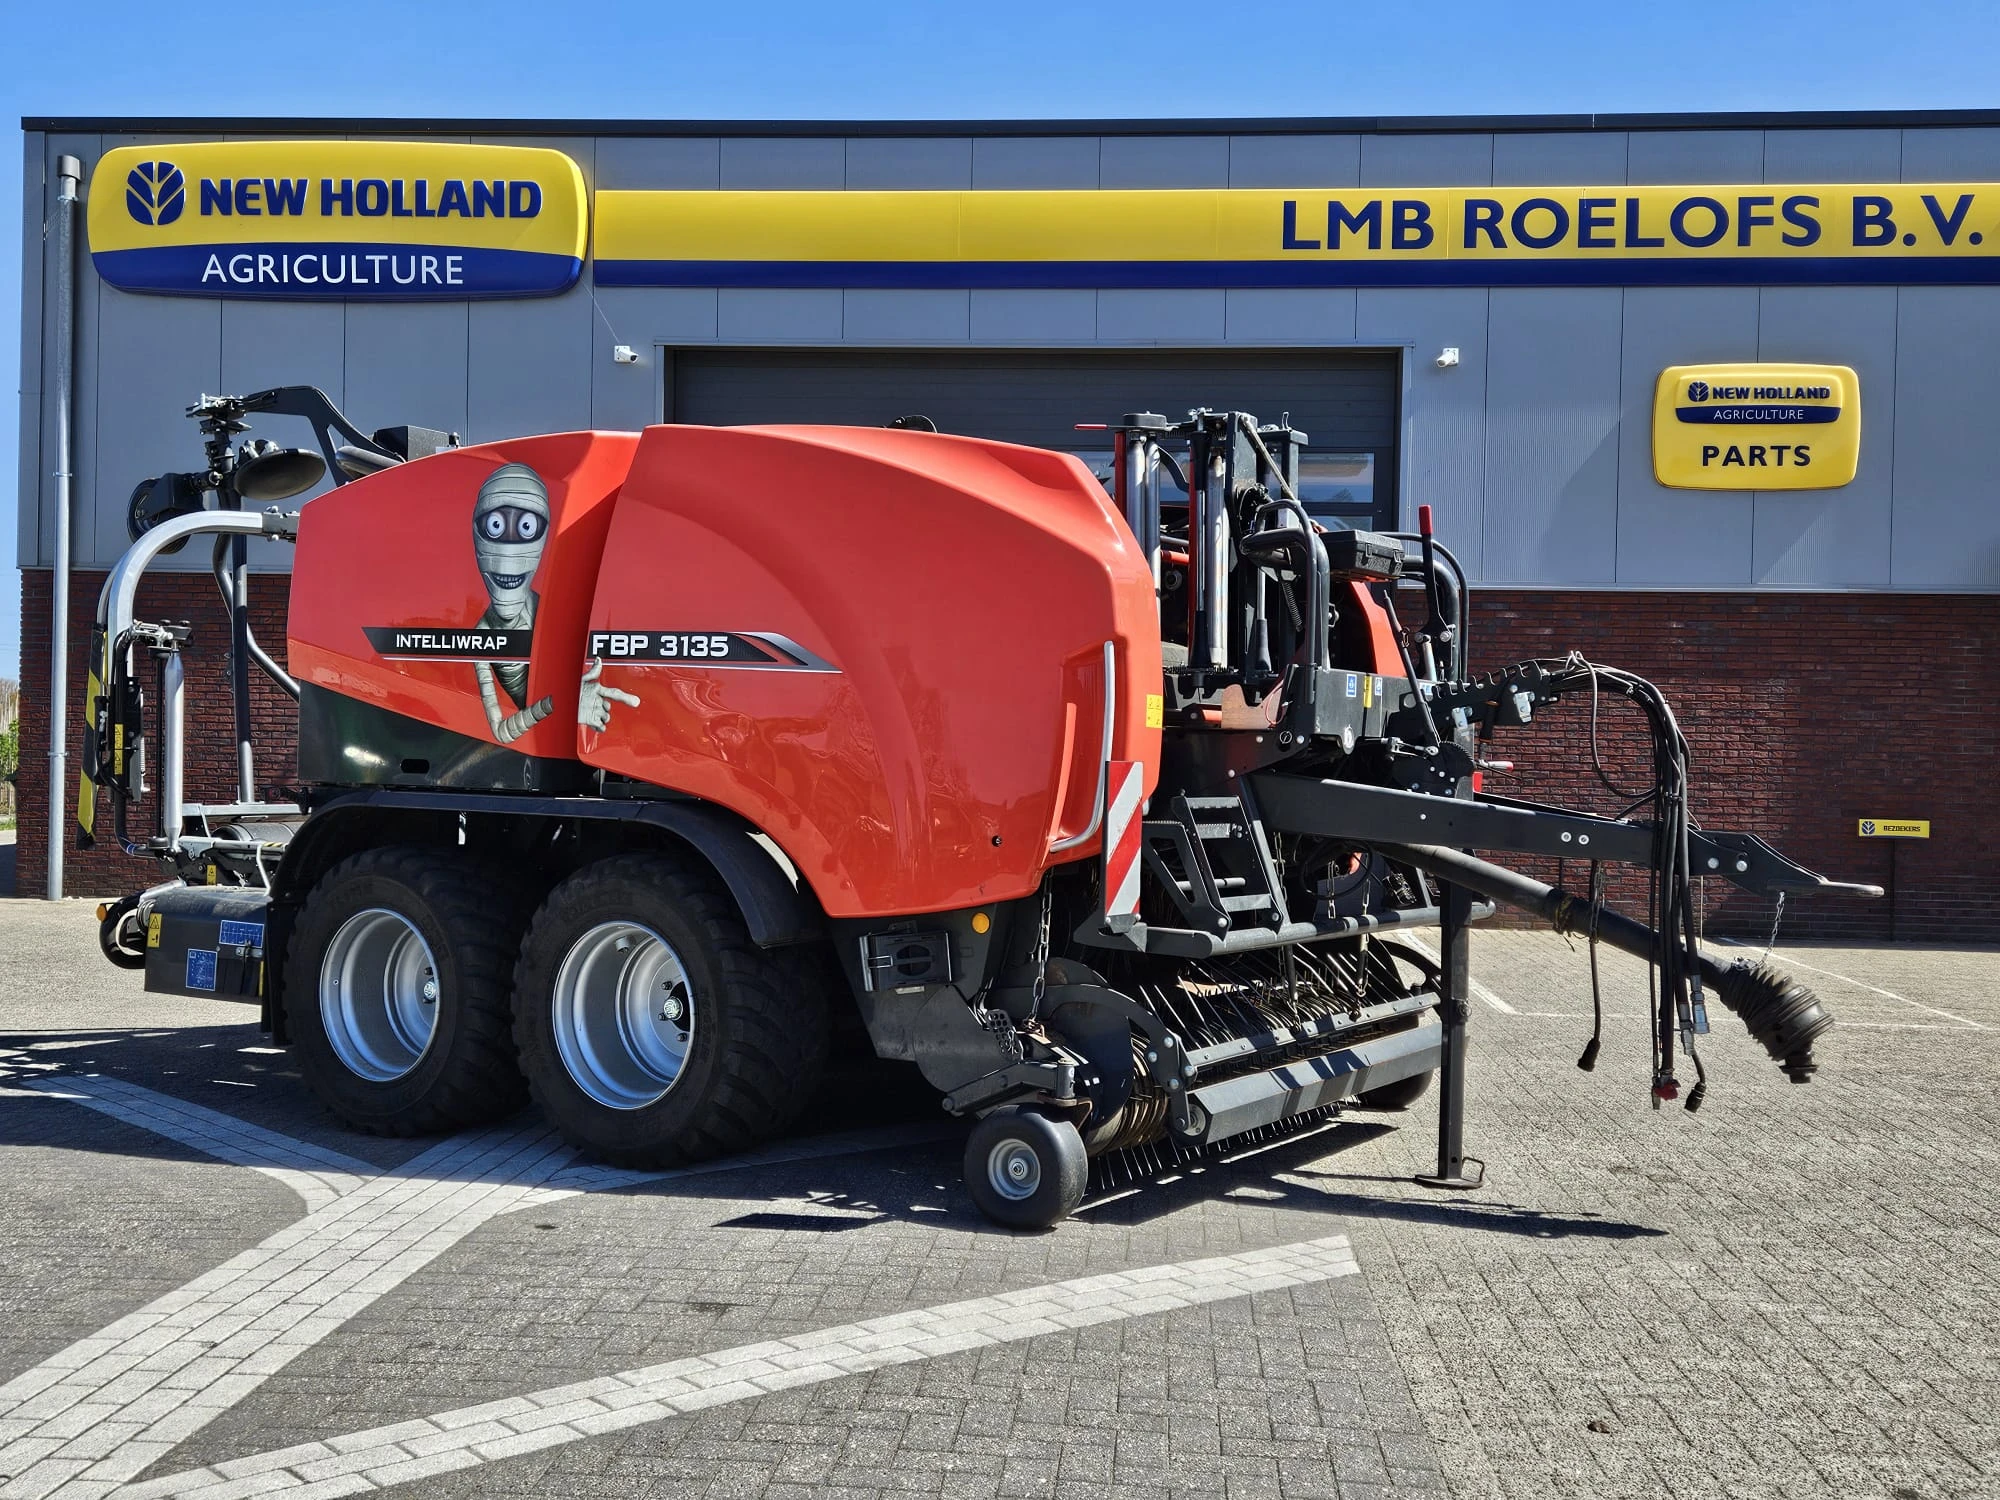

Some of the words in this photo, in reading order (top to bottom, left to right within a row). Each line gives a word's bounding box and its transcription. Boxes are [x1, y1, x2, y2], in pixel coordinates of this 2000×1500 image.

[200, 177, 308, 216] NEW
[320, 178, 543, 219] HOLLAND
[1282, 200, 1434, 250] LMB
[1463, 195, 1822, 250] ROELOFS
[1852, 194, 1983, 247] B.V.
[201, 254, 464, 285] AGRICULTURE
[1712, 386, 1750, 400] NEW
[1754, 386, 1831, 400] HOLLAND
[1713, 409, 1804, 420] AGRICULTURE
[1702, 445, 1811, 467] PARTS
[396, 633, 507, 650] INTELLIWRAP
[592, 634, 649, 656] FBP
[660, 635, 729, 657] 3135
